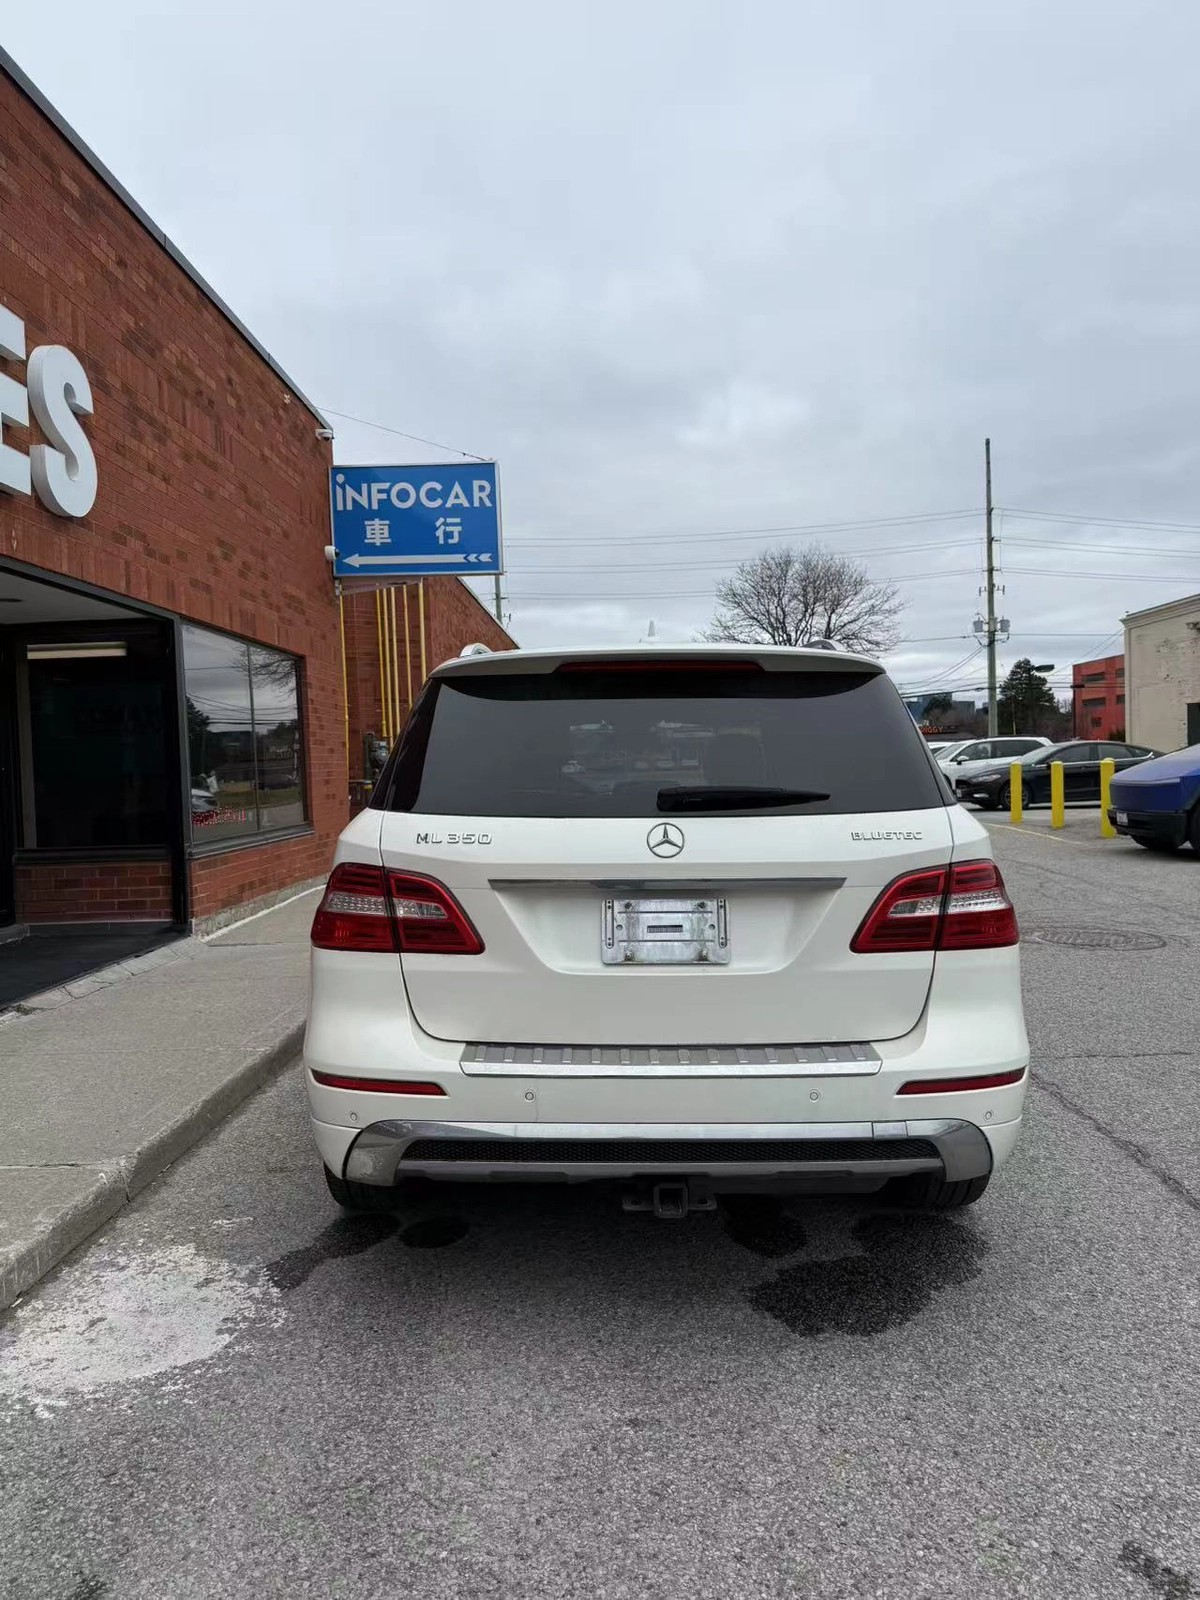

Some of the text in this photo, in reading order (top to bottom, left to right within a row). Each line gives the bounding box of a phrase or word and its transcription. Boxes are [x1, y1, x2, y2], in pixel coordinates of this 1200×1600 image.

[416, 832, 492, 845] ML 350
[850, 831, 923, 841] BLUETEC
